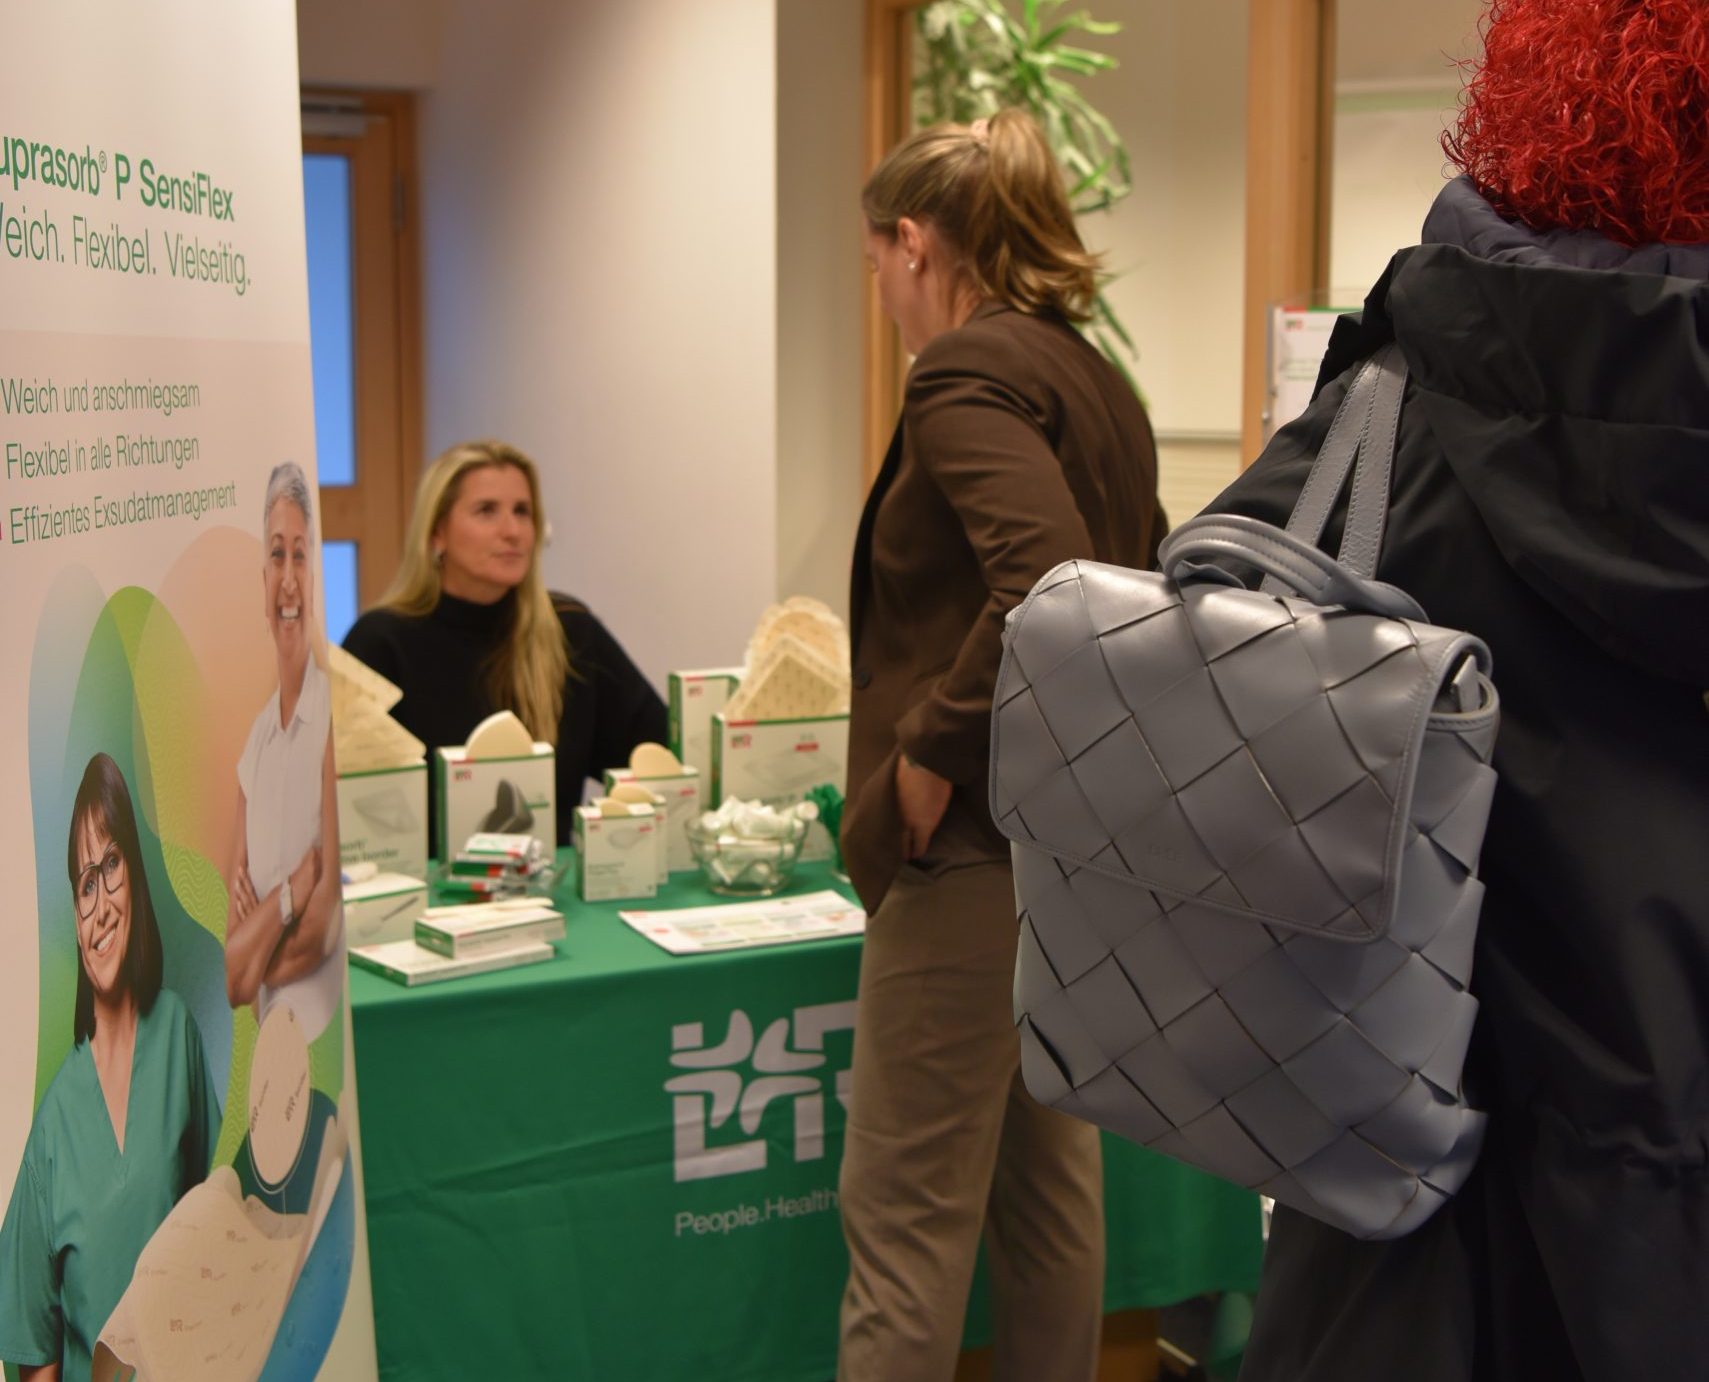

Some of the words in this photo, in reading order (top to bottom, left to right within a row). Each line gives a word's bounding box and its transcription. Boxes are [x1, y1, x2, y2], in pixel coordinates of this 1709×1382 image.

[115, 153, 131, 200] P
[140, 159, 235, 222] SensiFlex
[0, 202, 65, 263] eich.
[73, 215, 156, 275] Flexibel.
[164, 231, 251, 296] Vielseitig.
[1, 378, 58, 414] Weich
[64, 379, 88, 412] und
[93, 378, 200, 416] anschmiegsam
[6, 439, 71, 480] Flexibel
[75, 439, 87, 472] in
[91, 437, 111, 469] alle
[116, 434, 200, 469] Richtungen
[10, 504, 90, 545] Effizientes
[95, 480, 237, 529] Exsudatmanagement
